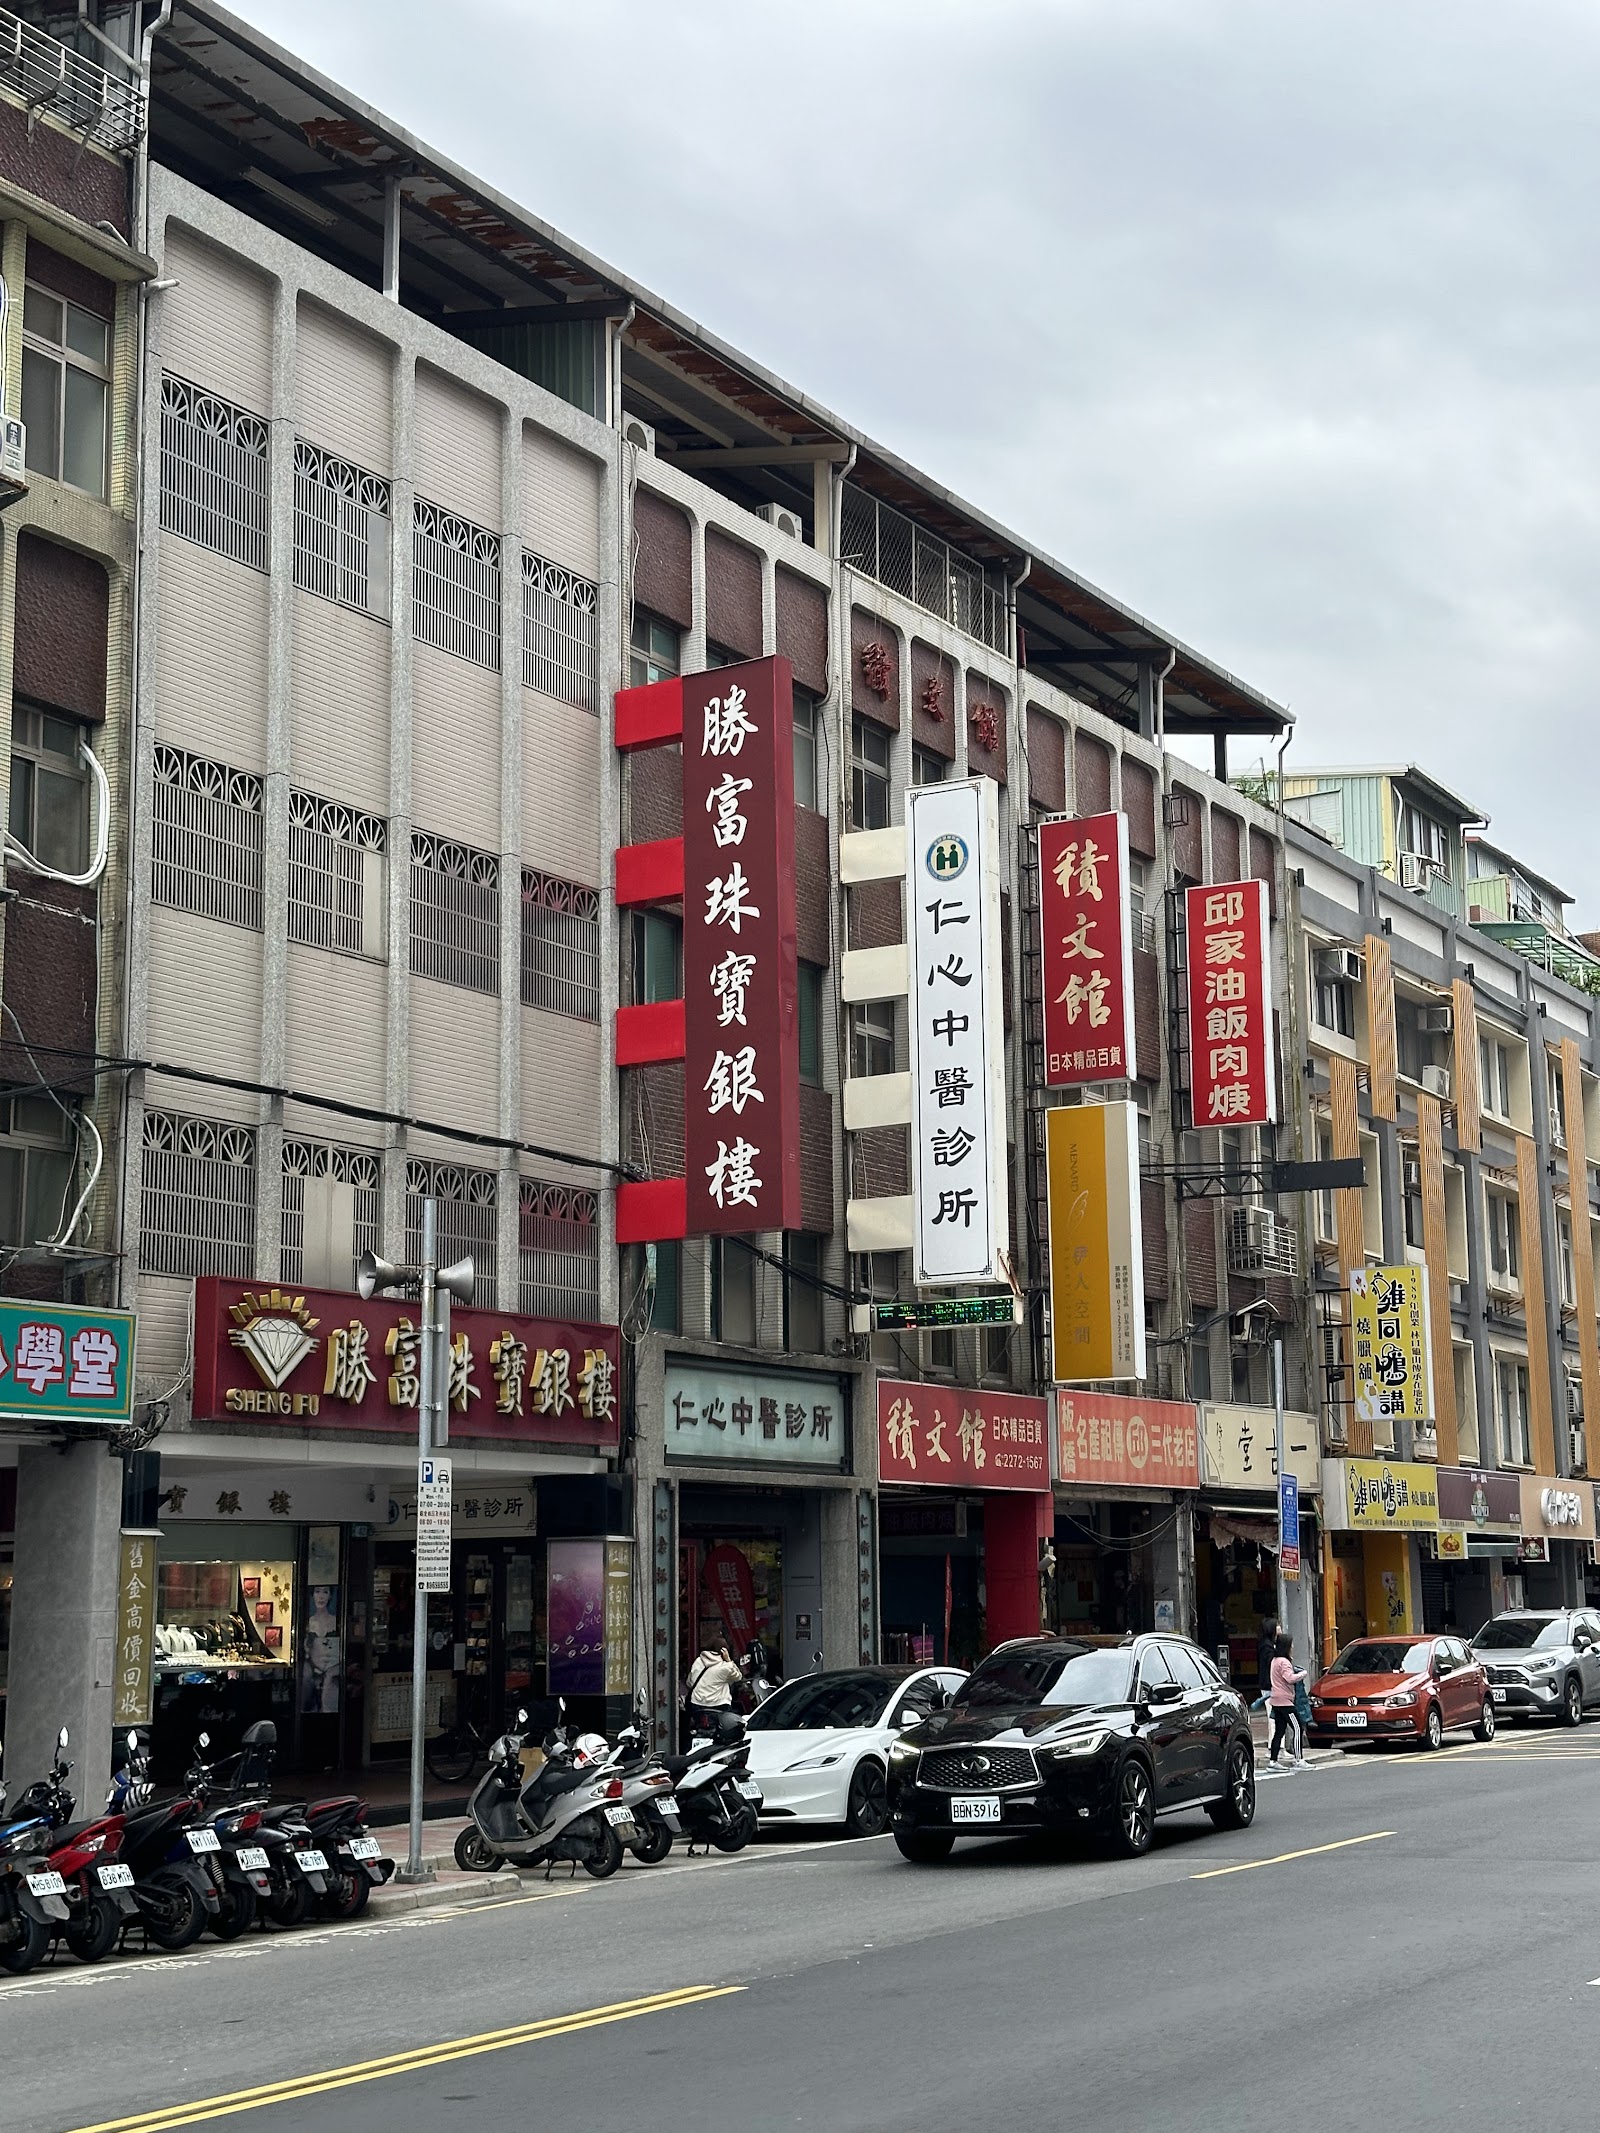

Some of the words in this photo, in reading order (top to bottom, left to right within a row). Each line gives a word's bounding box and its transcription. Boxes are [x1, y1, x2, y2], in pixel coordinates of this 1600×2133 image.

[701, 684, 765, 1210] 勝富珠寶銀樓
[1052, 839, 1111, 1028] 積文館
[1204, 891, 1251, 1119] 邱家油飯肉焿
[925, 898, 979, 1229] 仁心中醫診所
[1050, 1046, 1122, 1073] 日本精品百貨
[0, 1323, 119, 1396] 學堂
[226, 1388, 293, 1414] SHENG
[293, 1392, 320, 1416] FU
[672, 1390, 833, 1442] 仁心中醫診所
[886, 1397, 986, 1470] 積文館
[992, 1415, 1043, 1445] 日本精品百貨
[402, 1496, 524, 1520] 仁醫診所
[121, 1541, 147, 1716] 舊金高價回收
